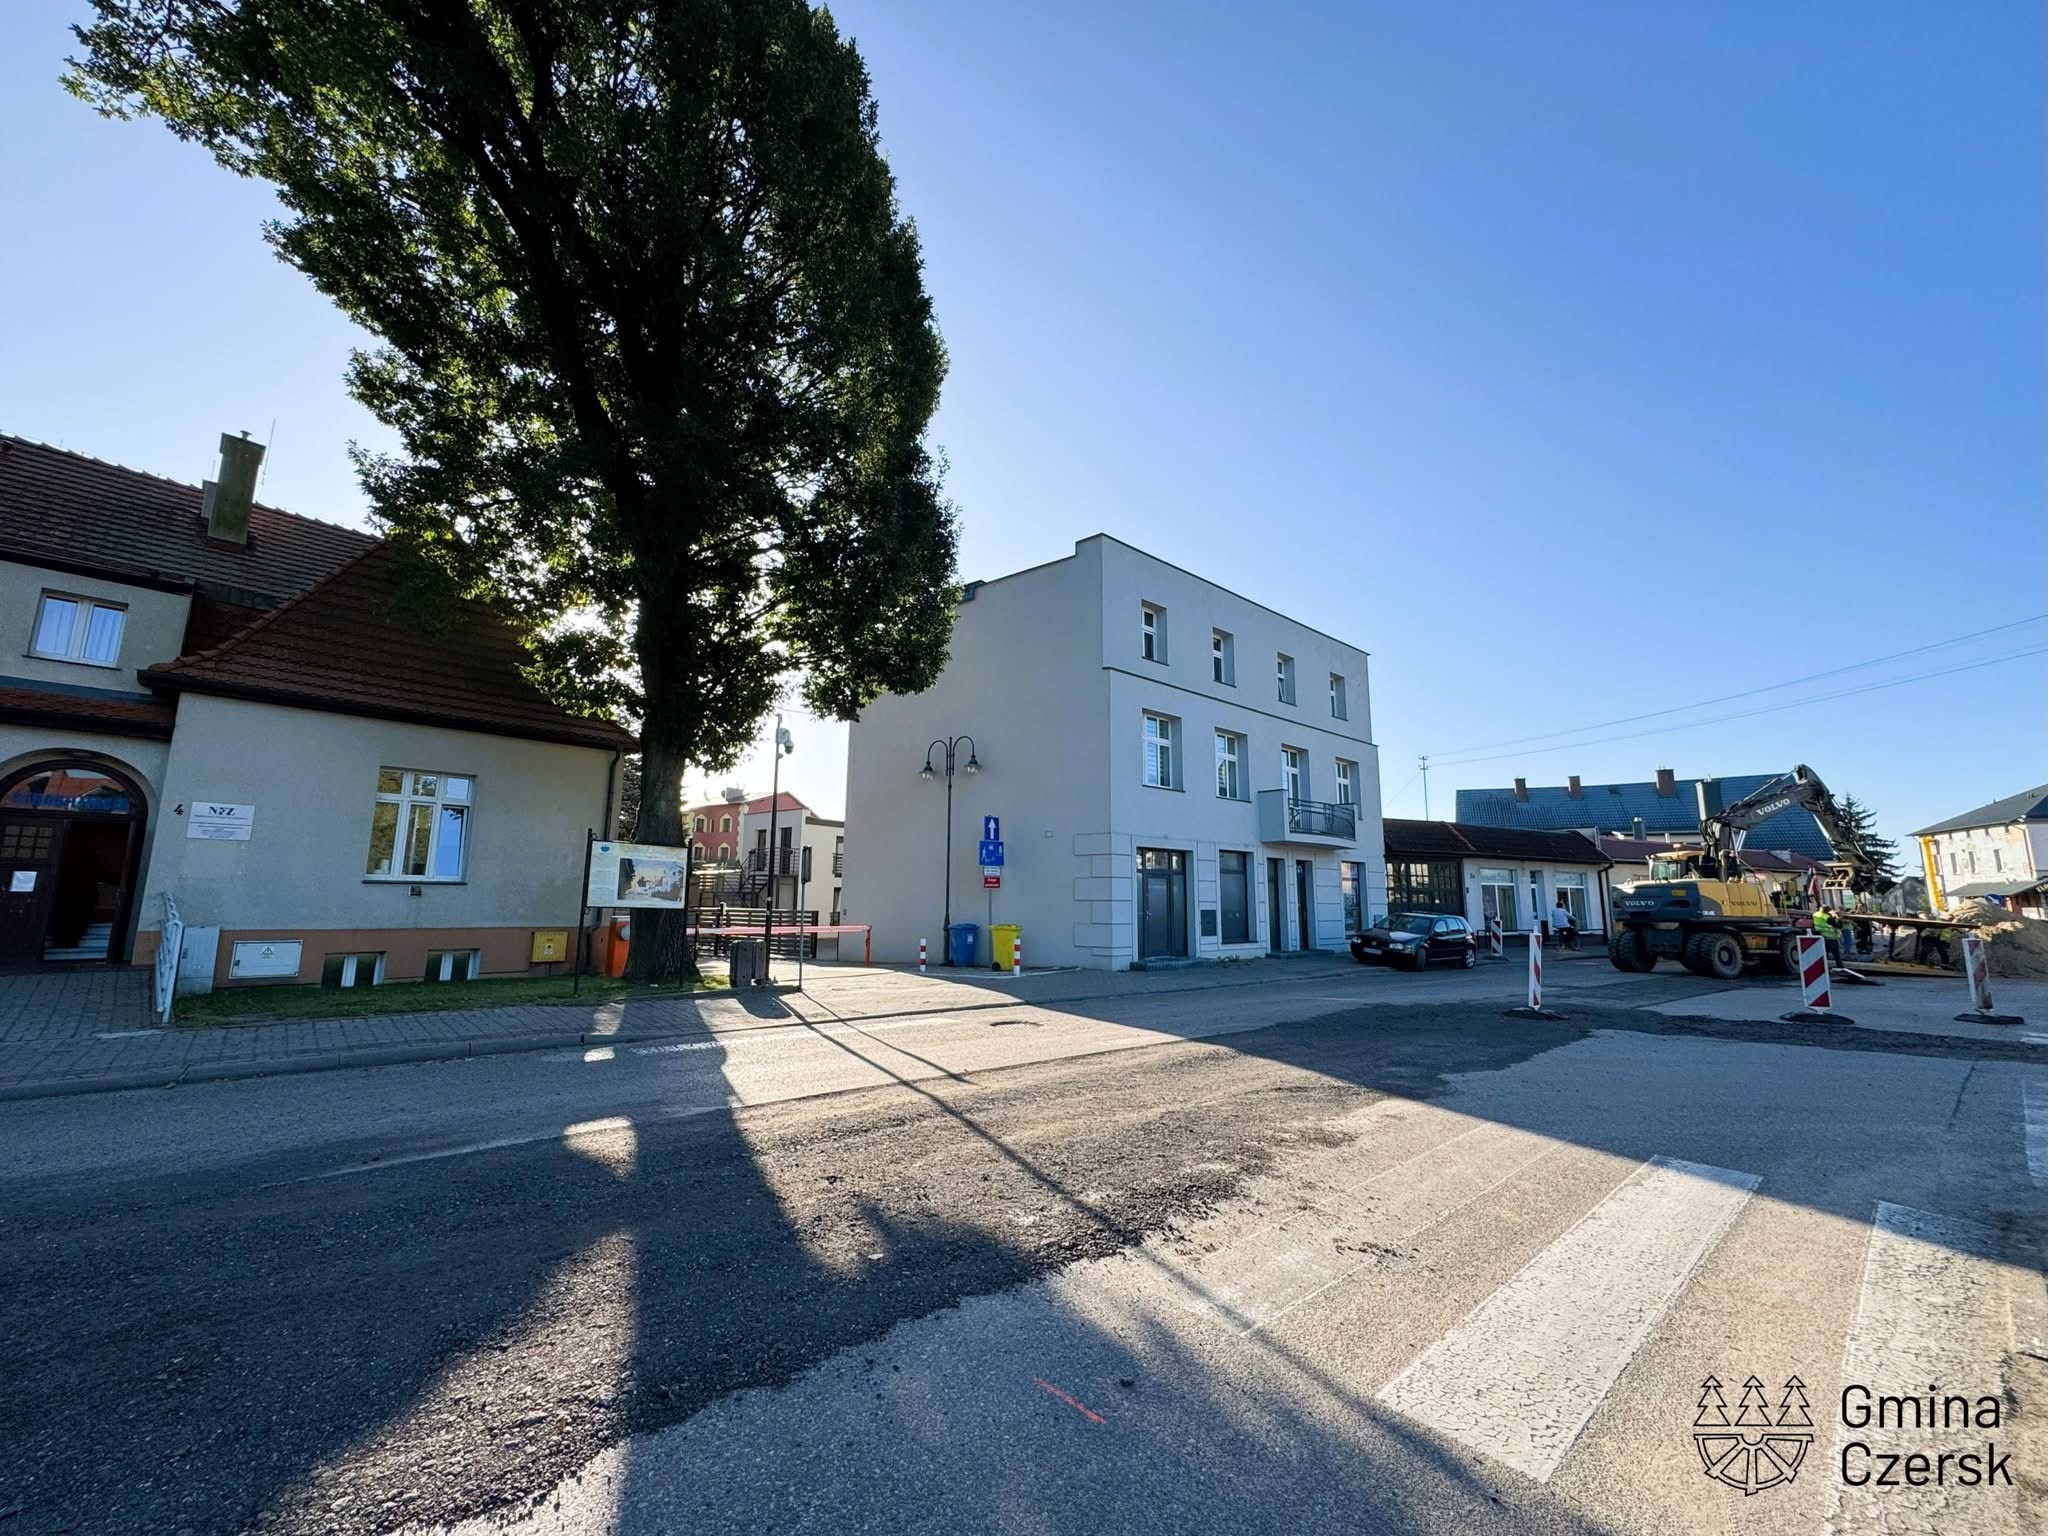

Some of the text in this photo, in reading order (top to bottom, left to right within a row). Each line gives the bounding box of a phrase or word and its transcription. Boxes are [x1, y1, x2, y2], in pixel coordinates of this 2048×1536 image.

[173, 803, 184, 815] 4
[208, 806, 235, 816] NFZ
[1756, 798, 1790, 815] VOLVO
